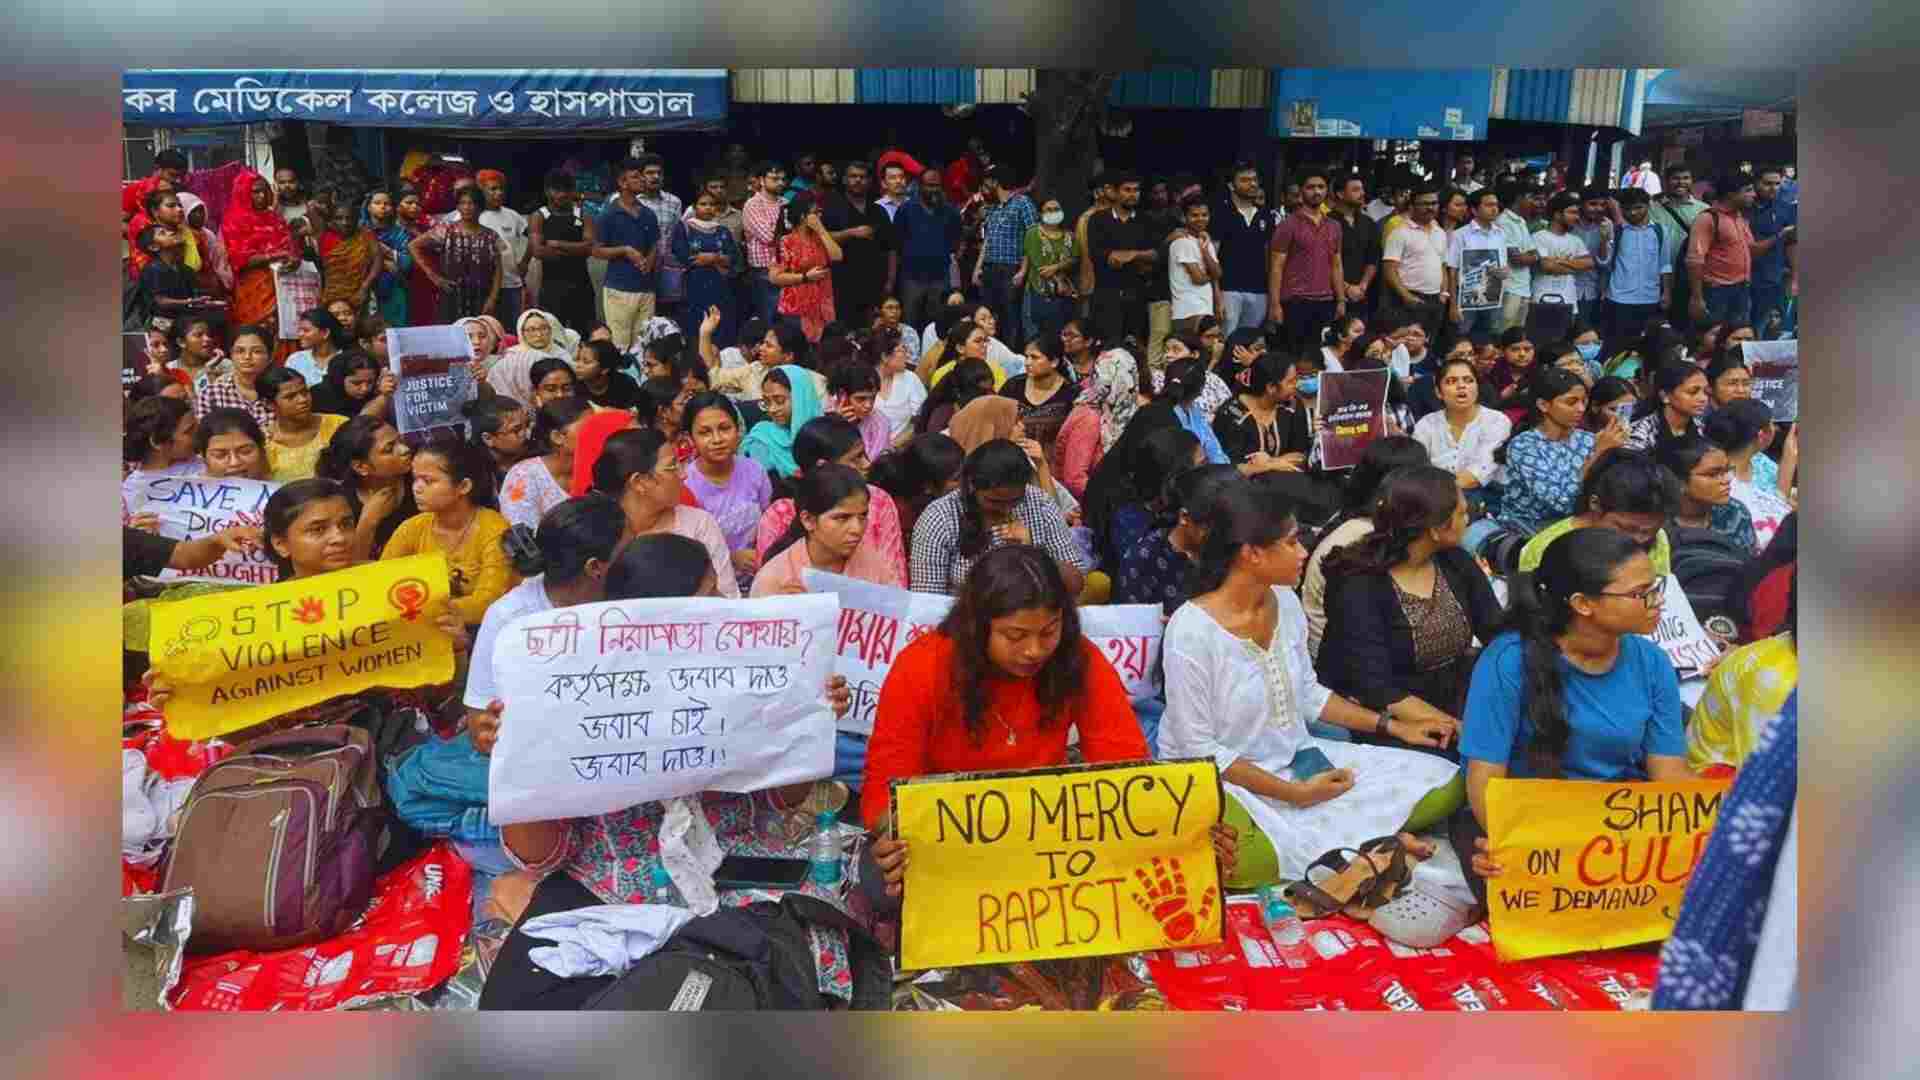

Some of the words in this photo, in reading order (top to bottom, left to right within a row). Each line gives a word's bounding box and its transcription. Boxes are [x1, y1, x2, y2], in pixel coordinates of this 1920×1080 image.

[121, 87, 178, 113] কর
[193, 77, 353, 115] মেডিকেল
[361, 88, 478, 117] কলেজ
[487, 89, 516, 115] ও
[524, 87, 696, 118] হাসপাতাল
[405, 375, 454, 392] JUSTICE
[406, 390, 429, 402] FOR
[407, 400, 449, 416] VICTIM
[146, 477, 242, 511] SAVE
[231, 587, 360, 637] STP
[220, 621, 392, 672] VIOLENCE
[211, 664, 328, 705] AGAINST
[339, 641, 422, 677] WOMEN
[667, 664, 737, 693] জবাব
[743, 664, 790, 691] দাও
[578, 709, 654, 740] জবাব
[569, 750, 648, 780] জবাব
[935, 787, 1011, 845] NO
[1027, 774, 1195, 843] MERCY
[1602, 787, 1722, 833] SHAM
[1035, 848, 1097, 880] TO
[1526, 847, 1561, 876] ON
[1577, 831, 1709, 888] CUL
[976, 876, 1127, 954] RAPIST
[1500, 888, 1540, 911] WE
[1549, 884, 1658, 913] DEMAND
